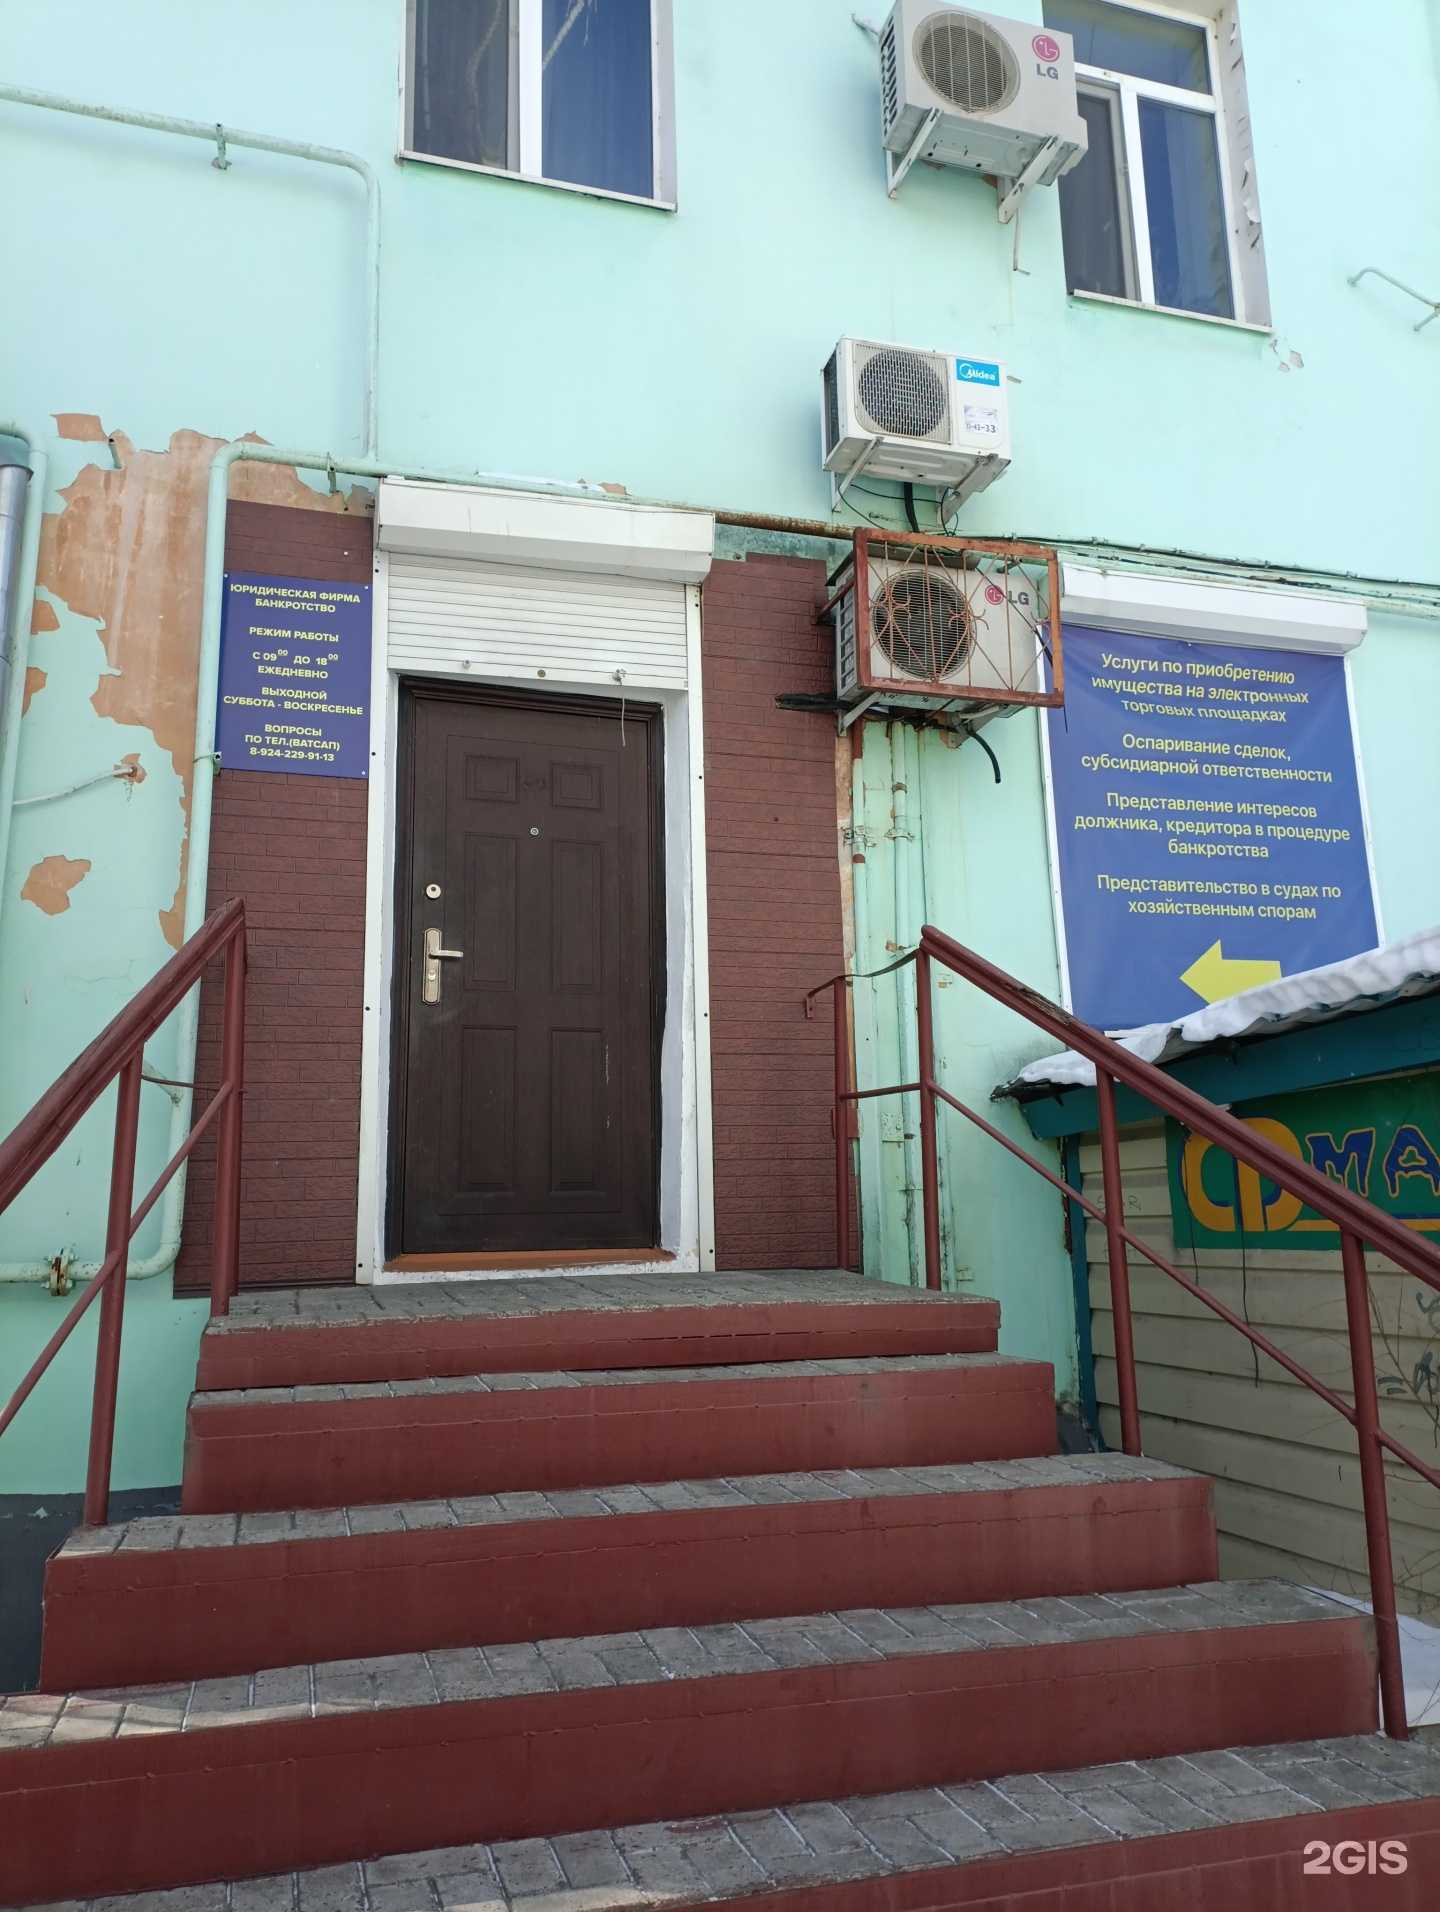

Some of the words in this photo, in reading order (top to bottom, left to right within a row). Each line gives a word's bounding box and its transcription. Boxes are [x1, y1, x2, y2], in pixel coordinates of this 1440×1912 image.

[1036, 63, 1059, 80] LG
[230, 583, 316, 600] ЮРИДИЧЕСКАЯ
[319, 591, 361, 604] ФИРМА
[1008, 590, 1030, 605] LG
[255, 598, 336, 613] БАНКРОТСТВО
[249, 627, 291, 638] РЕЖИМ
[294, 632, 339, 642] РАБОТЫ
[252, 652, 261, 660] С
[293, 655, 311, 665] ДО
[258, 665, 329, 679] ЕЖЕДНЕВНО
[1101, 653, 1159, 674] Услуги
[1162, 661, 1183, 674] по
[1186, 662, 1296, 685] приобретению
[261, 687, 328, 701] ВЫХОДНОЙ
[1091, 676, 1183, 696] имущества
[1186, 686, 1205, 698] на
[1208, 688, 1309, 704] электронных
[223, 695, 276, 708] СУББОТА
[284, 701, 364, 715] ВОСКРЕСЕНЬЕ
[1121, 701, 1195, 718] торговых
[1197, 707, 1287, 723] площадках
[264, 724, 322, 737] ВОПРОСЫ
[245, 734, 262, 744] ПО
[265, 736, 341, 751] ТЕЛ.(ВАТСАП)
[1122, 733, 1231, 756] Оспаривание
[1233, 745, 1292, 761] сделок,
[249, 747, 335, 762] 8-924-229-91-13
[1081, 753, 1199, 776] субсидиарной
[1202, 765, 1333, 783] ответственности
[1106, 792, 1234, 815] Представление
[1237, 804, 1318, 819] интересов
[1074, 814, 1163, 833] должника,
[1166, 822, 1252, 838] кредитора
[1255, 826, 1264, 836] в
[1267, 825, 1351, 842] процедуре
[1168, 839, 1269, 858] банкротства
[1097, 874, 1258, 896] Представительство
[1261, 884, 1270, 895] в
[1274, 885, 1318, 899] судах
[1322, 887, 1341, 898] по
[1128, 899, 1255, 918] хозяйственным
[1258, 905, 1316, 921] спорам
